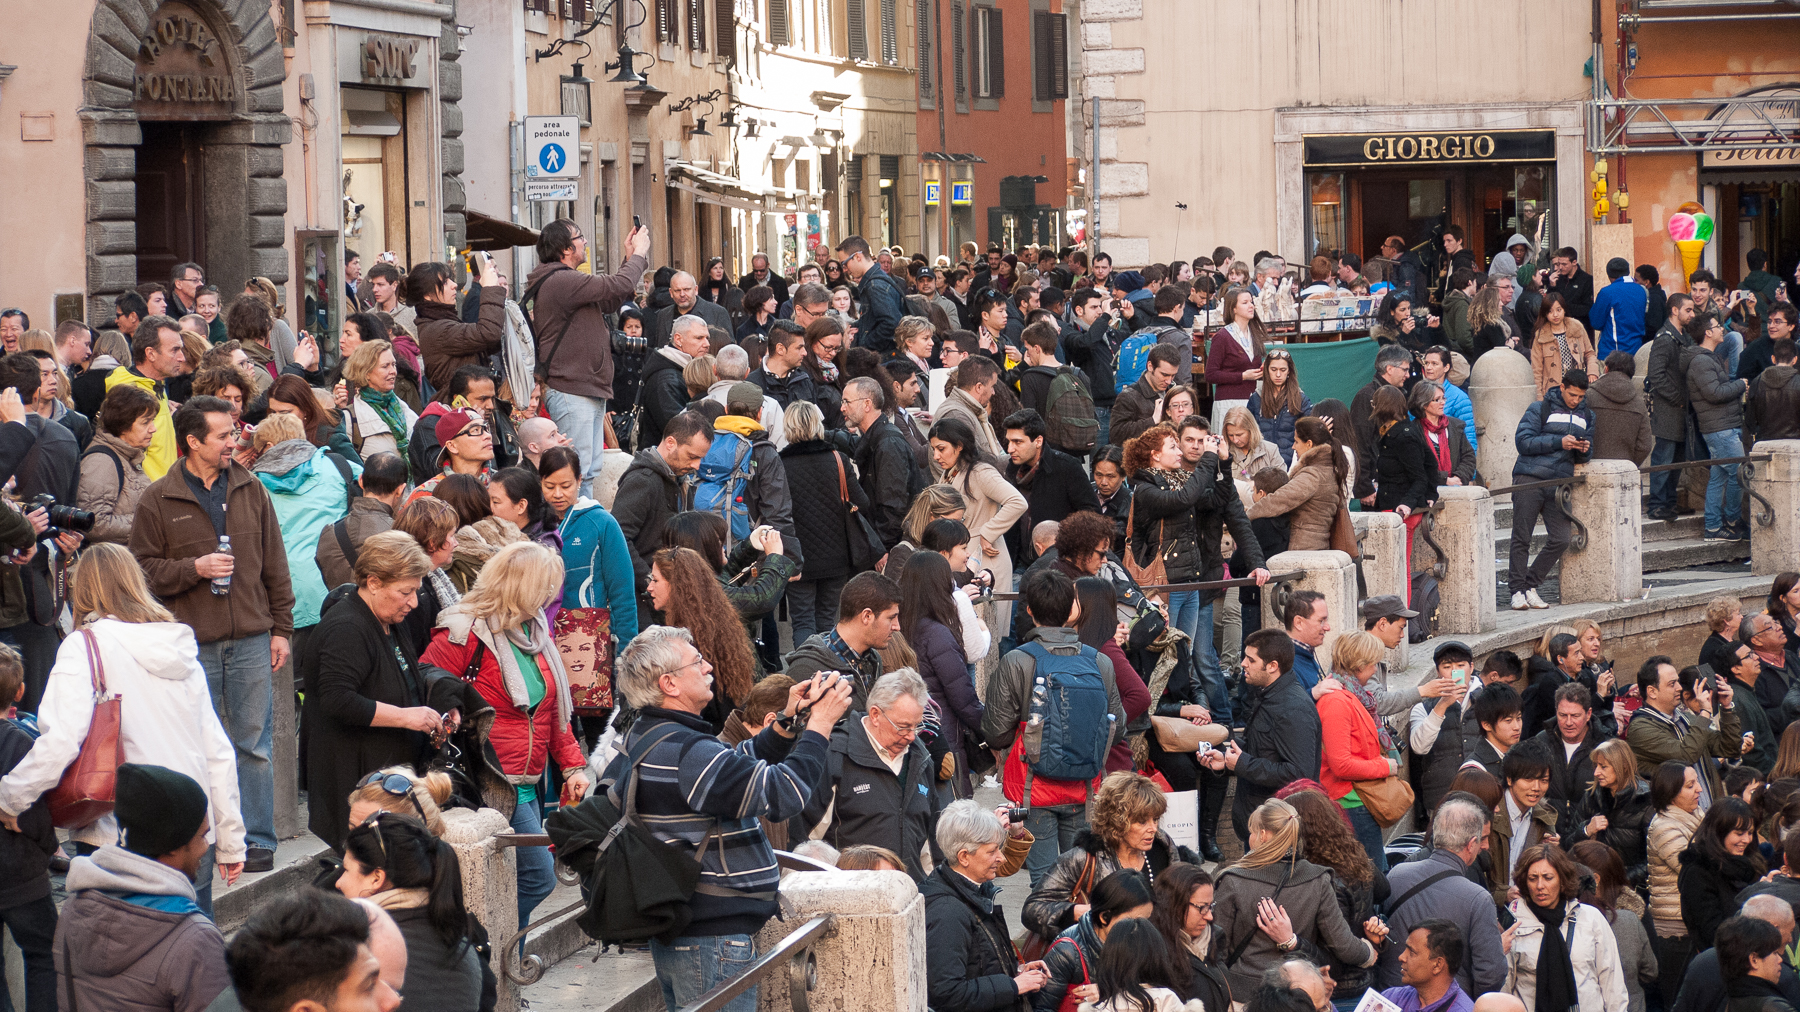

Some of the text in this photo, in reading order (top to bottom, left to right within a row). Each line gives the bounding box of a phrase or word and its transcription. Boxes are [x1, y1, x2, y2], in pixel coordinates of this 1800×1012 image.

[140, 16, 220, 66] HOTEL
[134, 73, 235, 101] FONTANA
[534, 129, 570, 139] pedonale
[1363, 135, 1495, 160] GIORGIO
